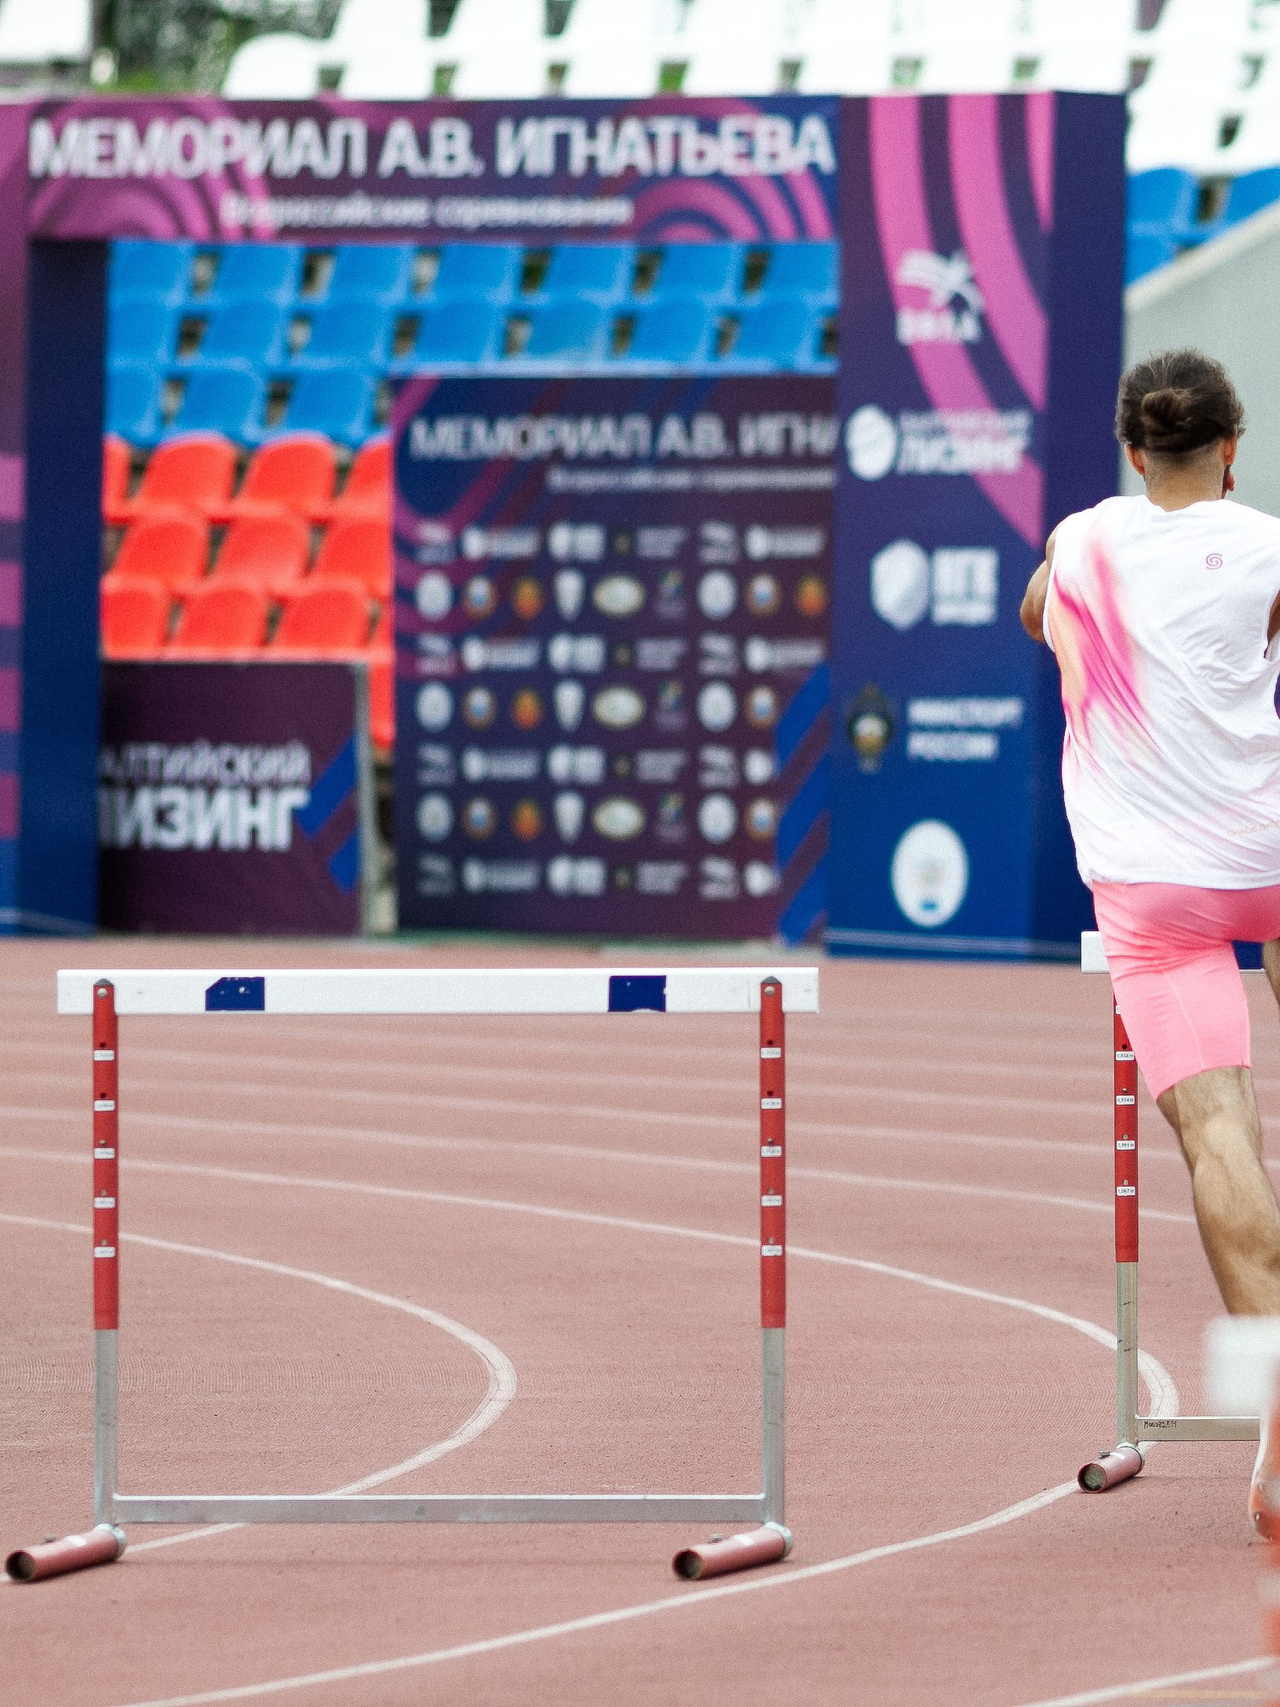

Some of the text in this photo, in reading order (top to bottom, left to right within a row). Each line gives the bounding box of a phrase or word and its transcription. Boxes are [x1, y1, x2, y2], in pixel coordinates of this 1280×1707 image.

[29, 116, 836, 178] МЕМОРИАЛ А.В. ИГНАТЬЕВА
[409, 412, 653, 461] МЕМОРИАЛ
